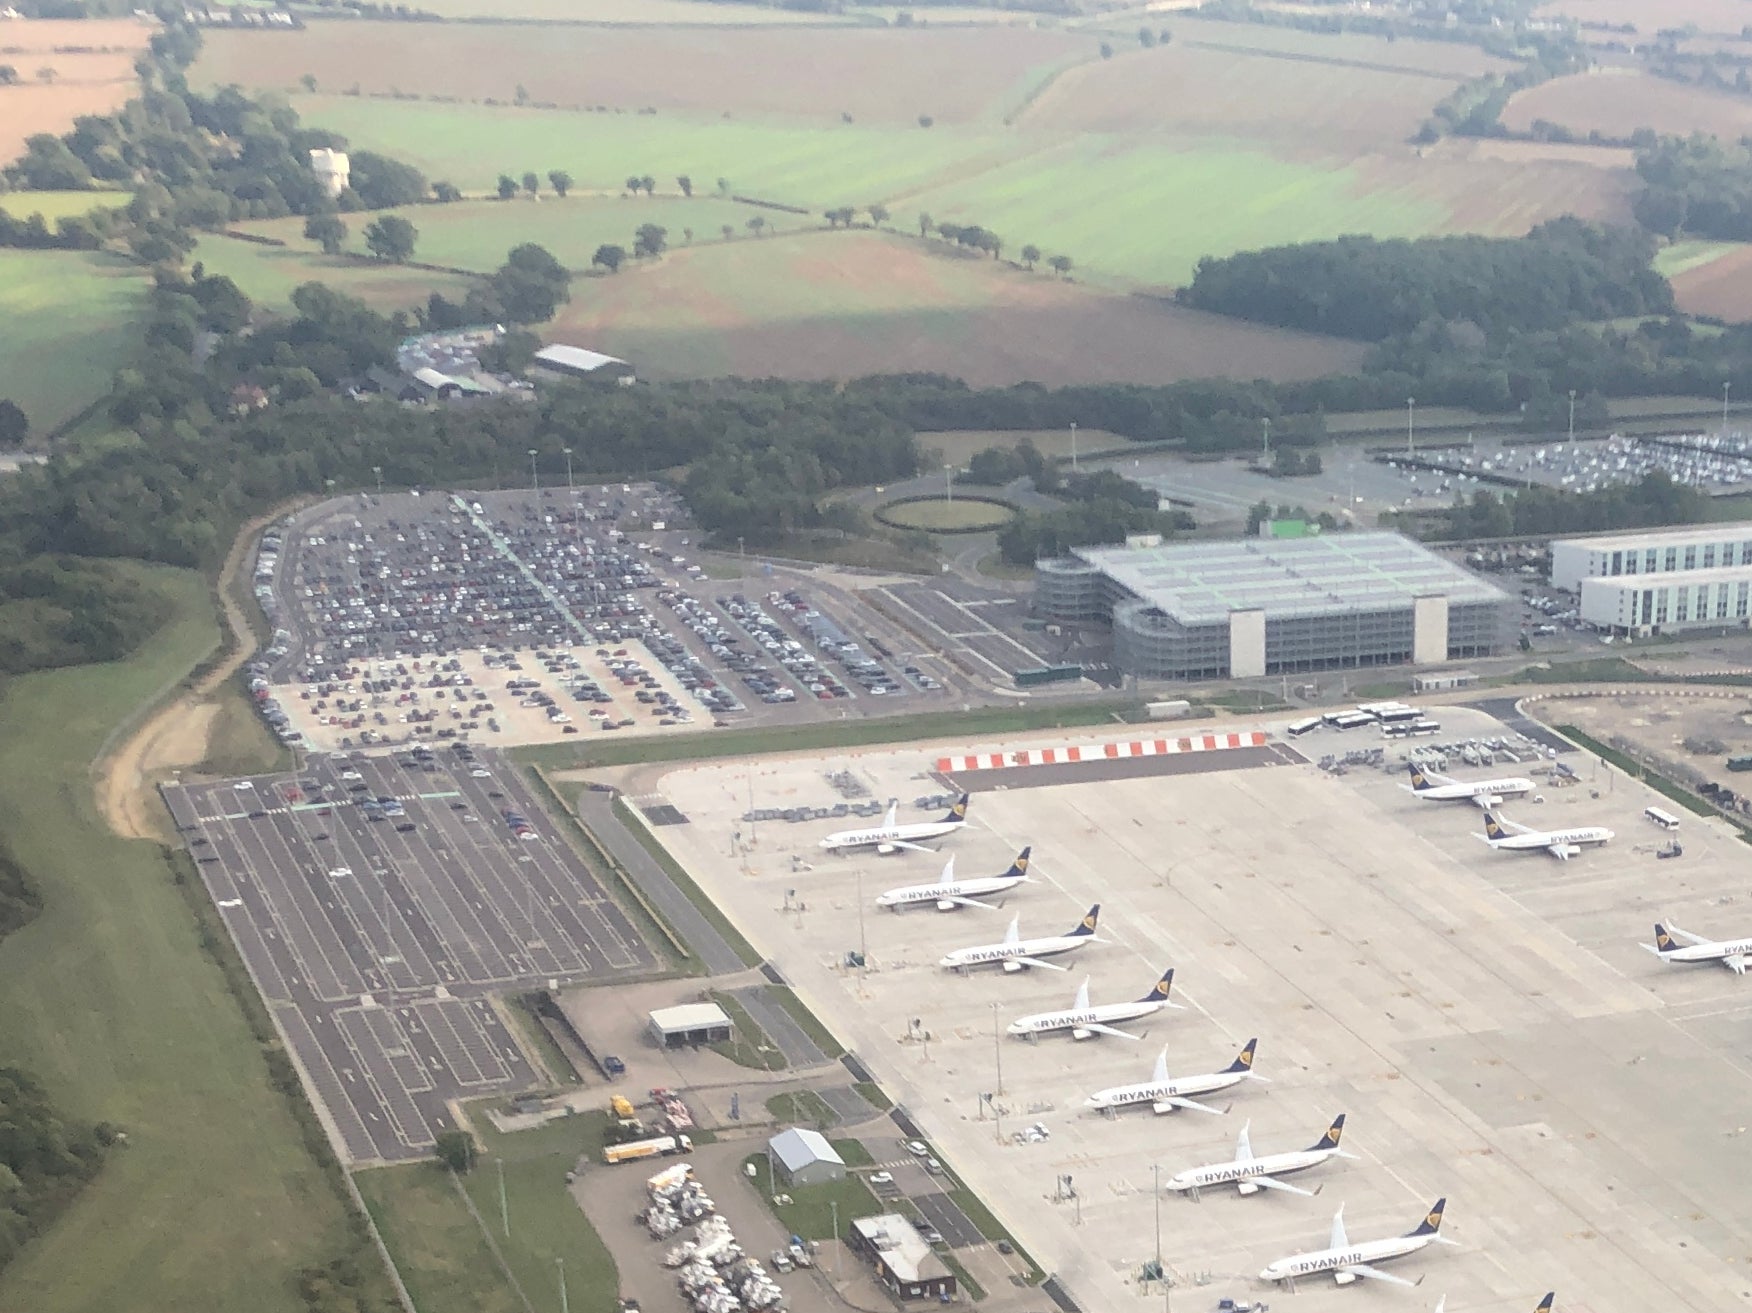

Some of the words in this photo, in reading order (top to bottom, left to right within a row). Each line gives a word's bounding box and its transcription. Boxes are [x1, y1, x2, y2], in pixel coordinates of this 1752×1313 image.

[849, 832, 899, 842] RYANAIR
[908, 887, 961, 899] RYANAIR
[972, 947, 1026, 960] RYANAIR
[1041, 1013, 1097, 1027] RYANAIR
[1119, 1086, 1177, 1101] RYANAIR
[1205, 1165, 1265, 1181] RYANAIR
[1300, 1253, 1361, 1271] RYANAIR
